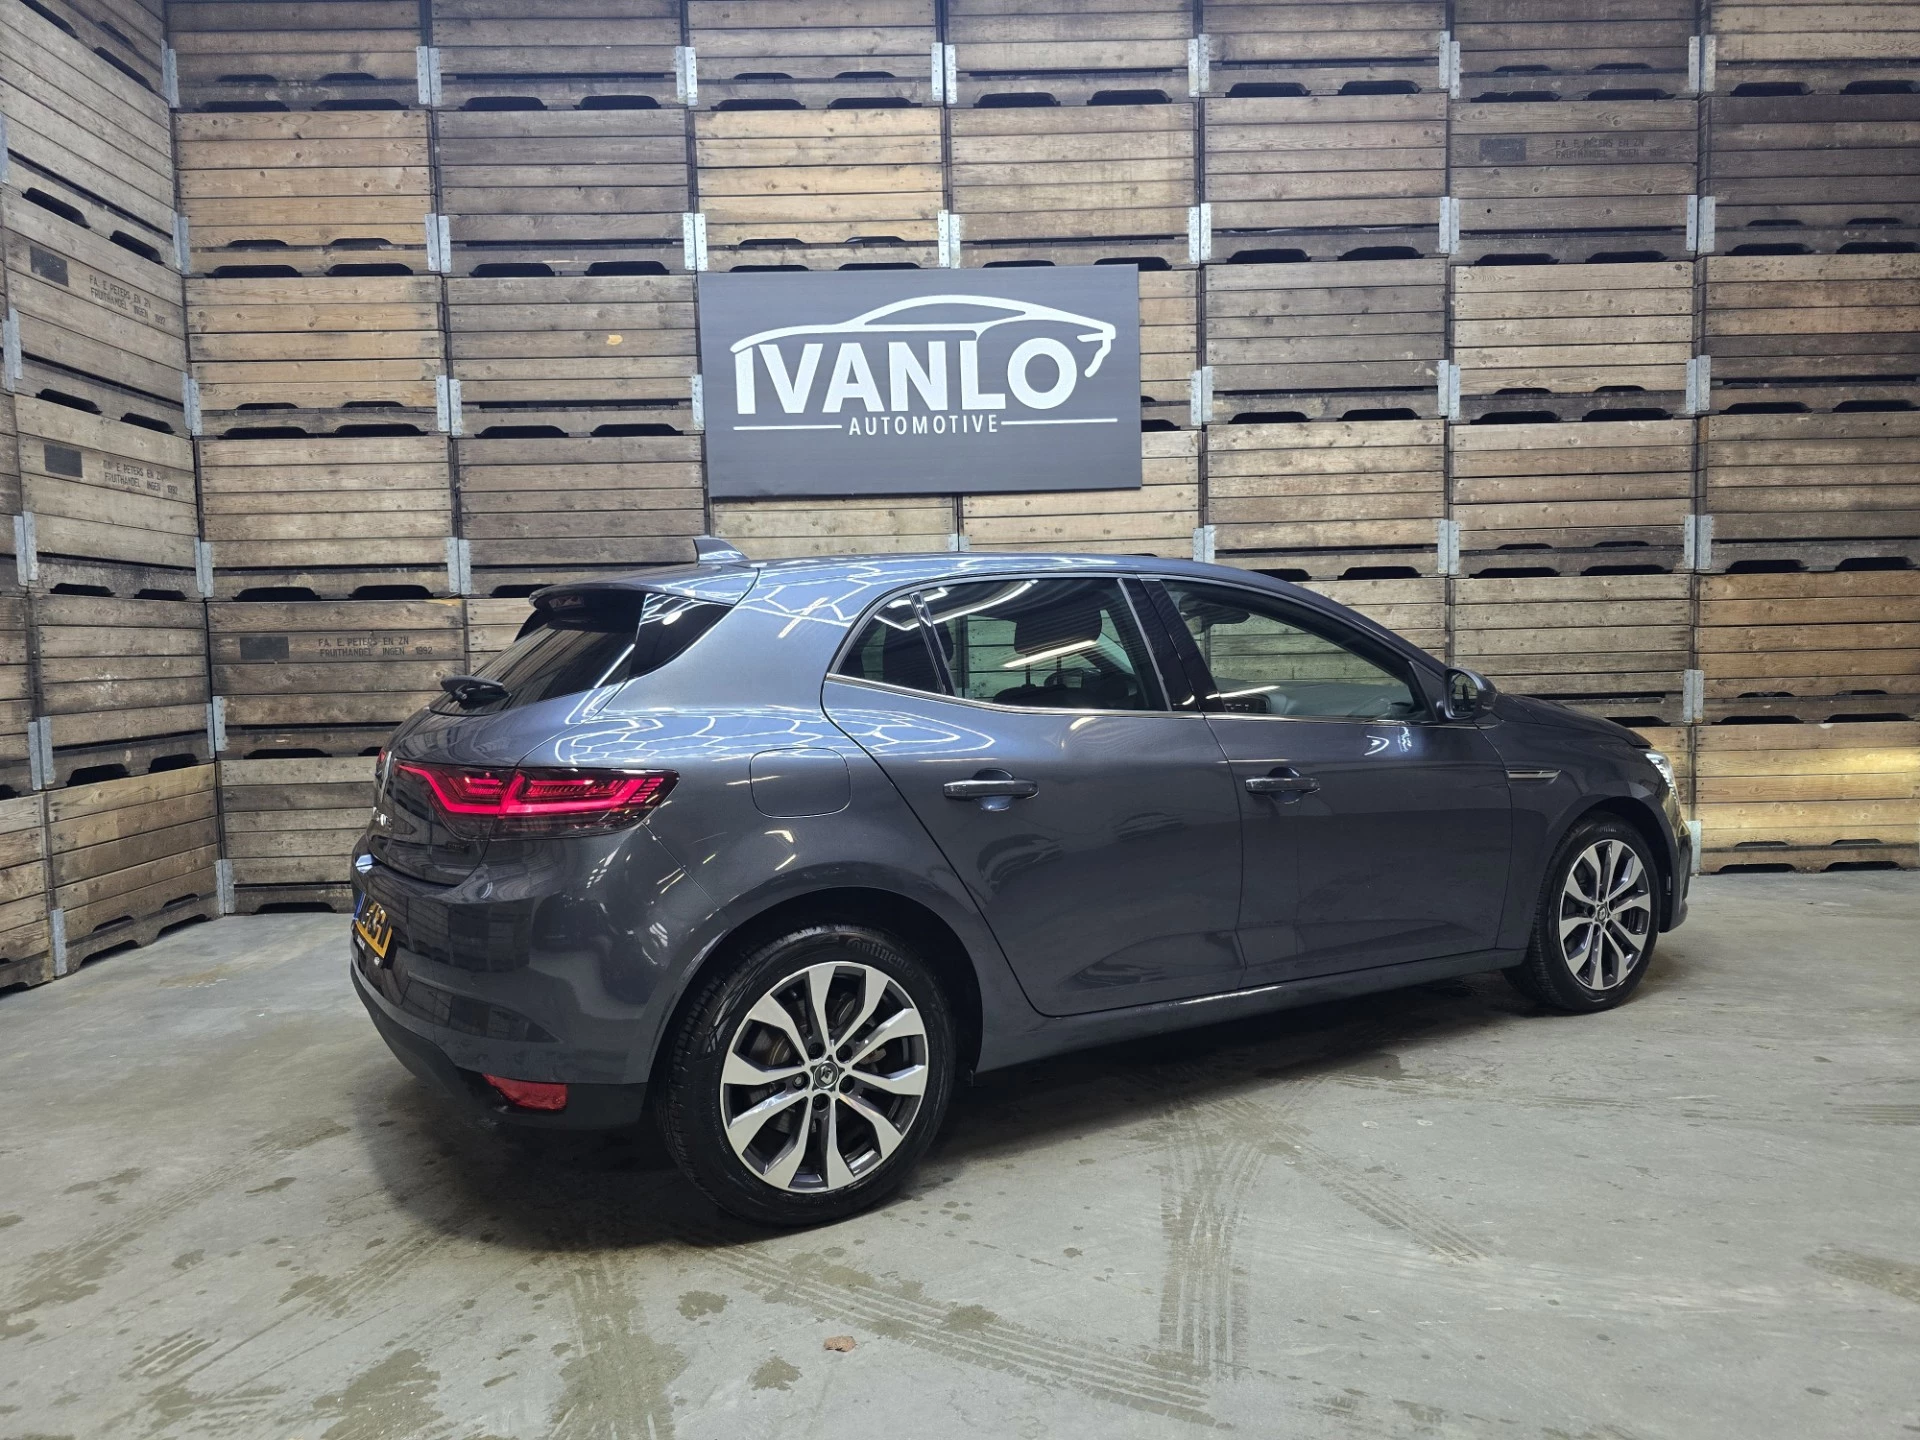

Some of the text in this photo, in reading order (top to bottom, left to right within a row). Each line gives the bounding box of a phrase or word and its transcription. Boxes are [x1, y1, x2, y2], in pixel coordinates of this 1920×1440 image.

[90, 287, 128, 310] FRUITHANDEL
[110, 283, 130, 300] PETERS
[134, 293, 141, 304] EN
[735, 337, 1078, 415] IVANLO
[849, 414, 998, 436] AUTOMOTIVE
[124, 464, 144, 477] PETERS
[320, 646, 433, 657] FRUITHANDEL INGEN 1992
[347, 637, 377, 647] PETERS
[383, 637, 393, 645] EN
[399, 636, 409, 645] ZN
